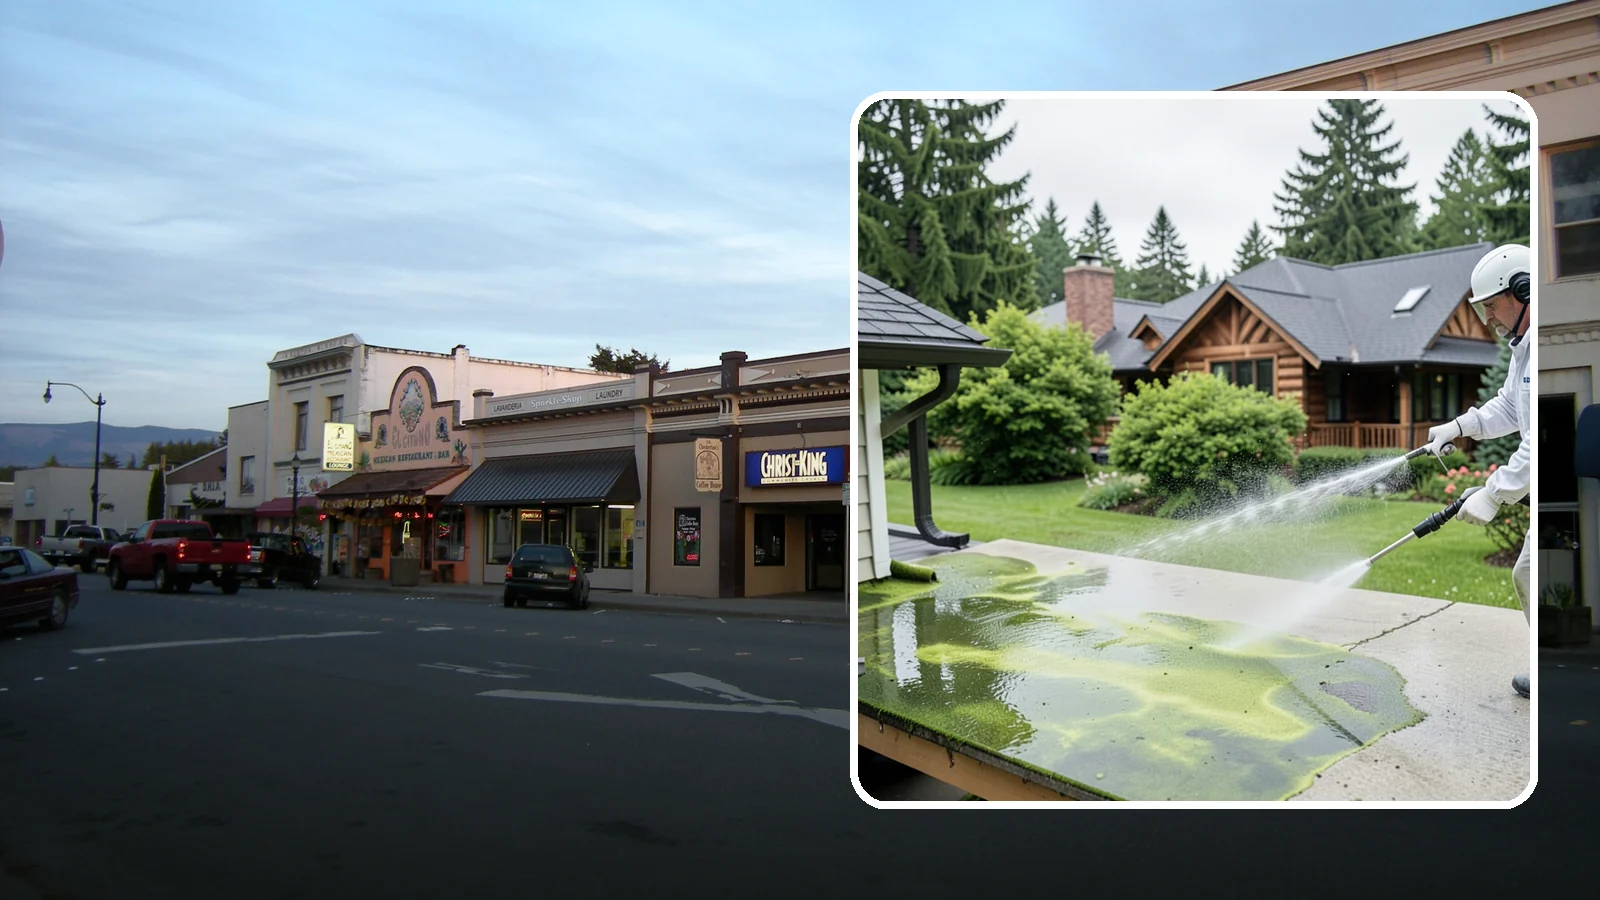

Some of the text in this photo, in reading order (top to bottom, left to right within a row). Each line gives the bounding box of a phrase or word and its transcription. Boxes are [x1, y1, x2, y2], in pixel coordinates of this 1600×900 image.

[595, 389, 623, 400] LAUNDRY
[493, 402, 522, 412] LAVANDERIA
[392, 425, 401, 449] EL
[373, 450, 450, 465] MEXICAN RESTAURANT BAR
